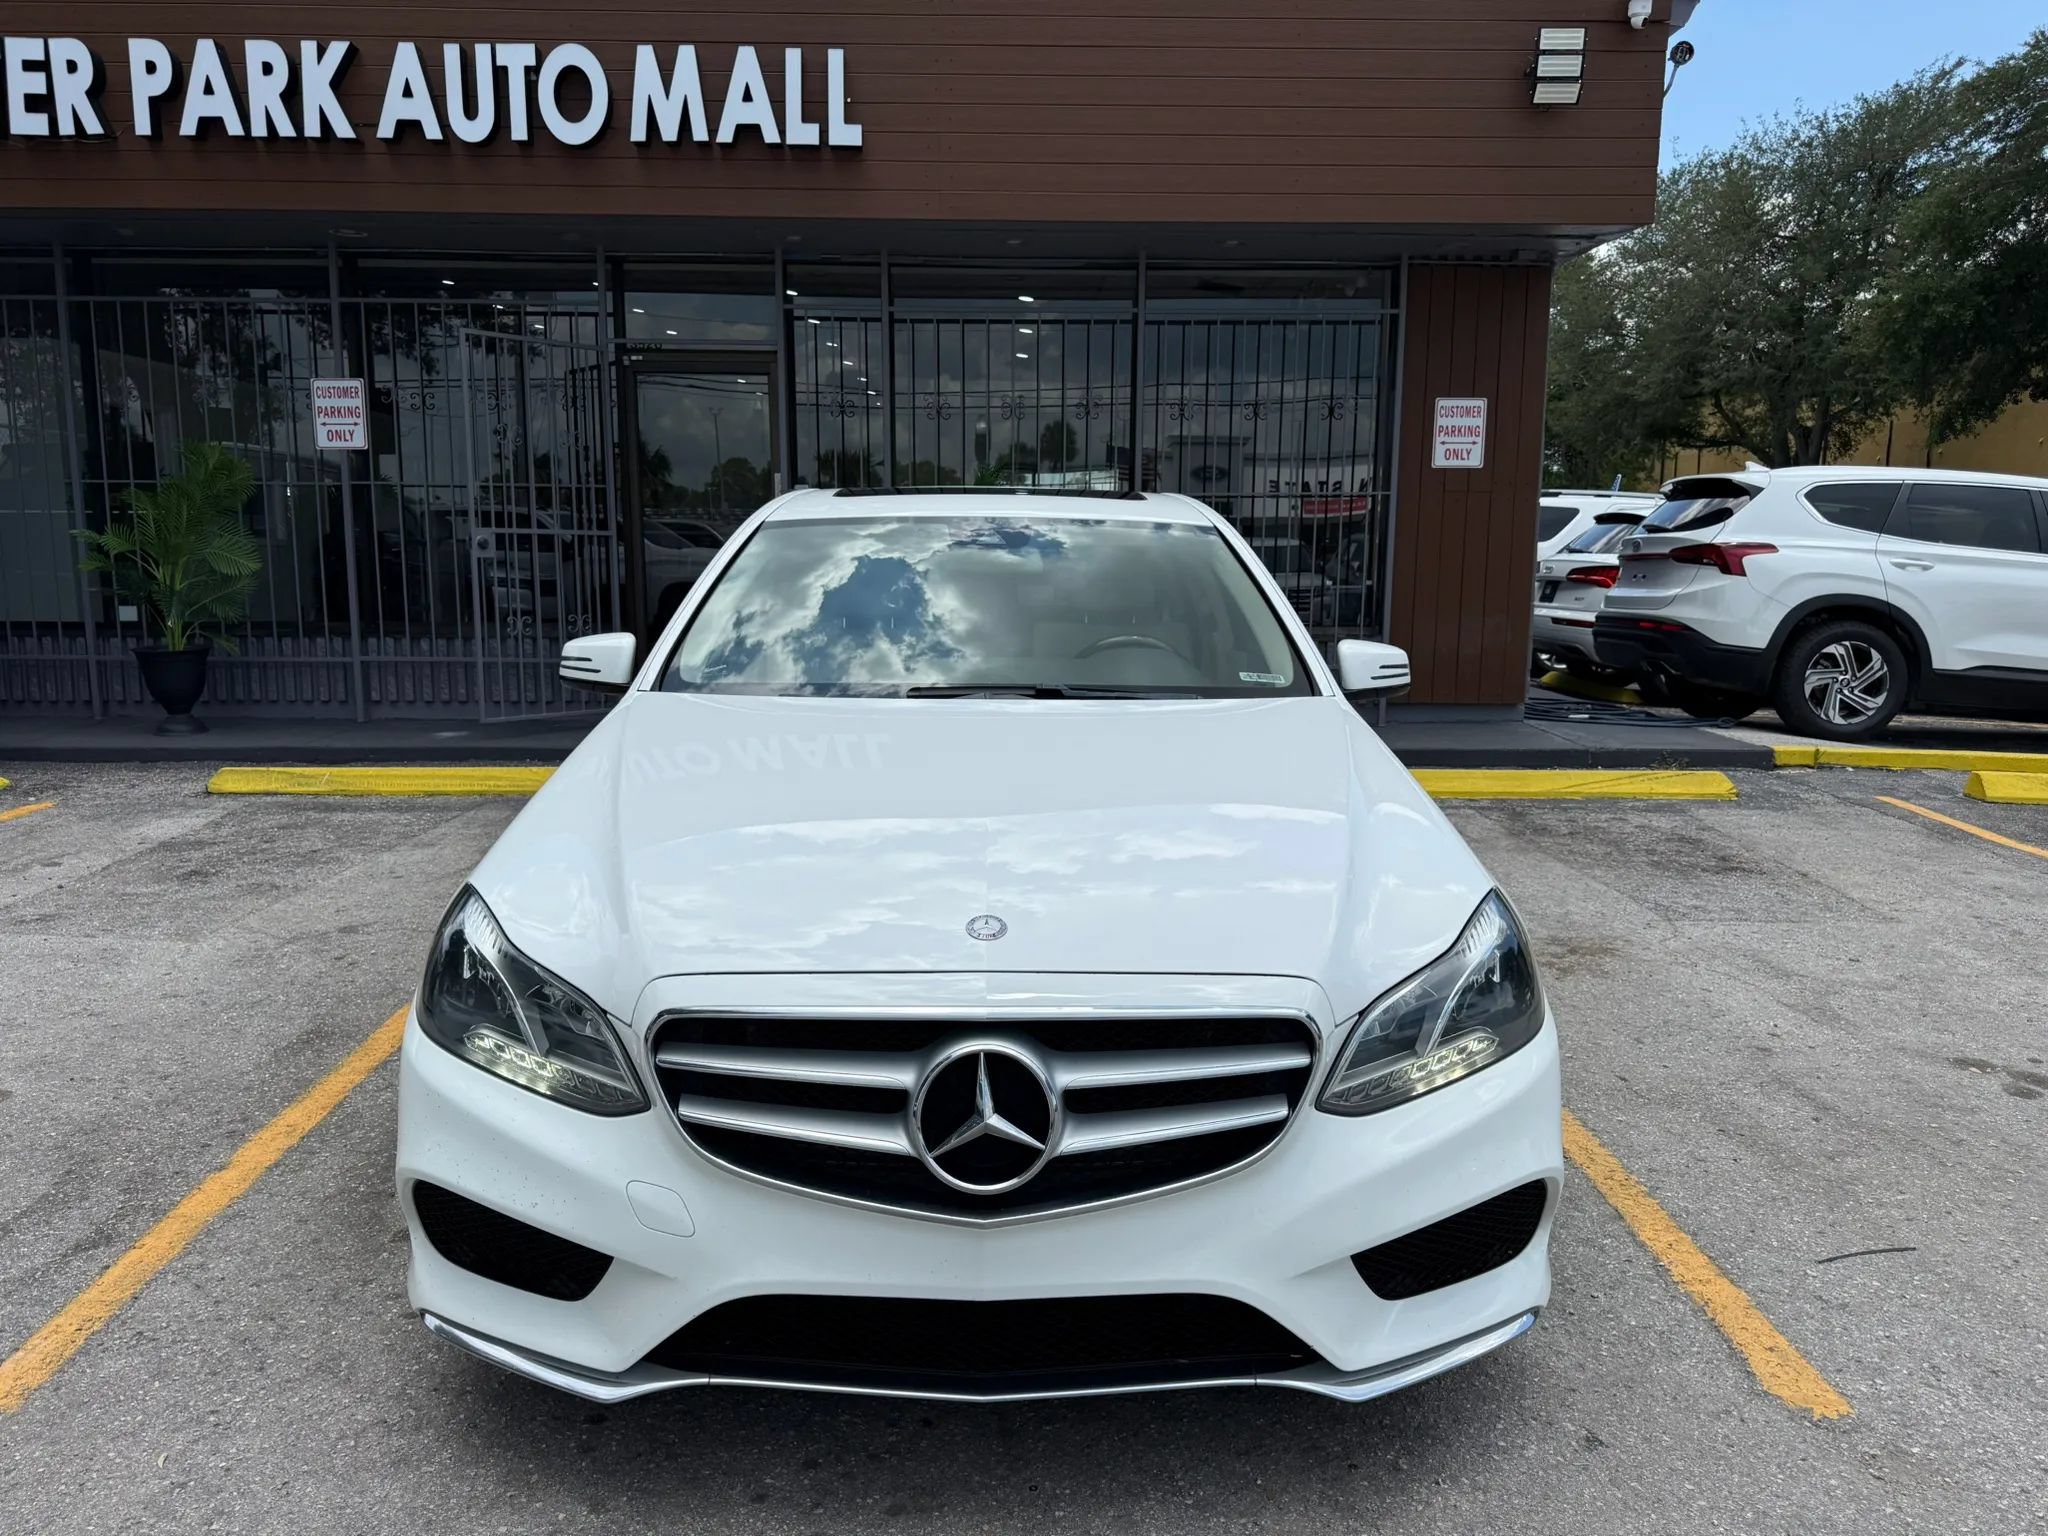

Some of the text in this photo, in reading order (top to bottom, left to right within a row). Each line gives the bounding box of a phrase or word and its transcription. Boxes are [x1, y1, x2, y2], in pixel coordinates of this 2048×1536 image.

[127, 37, 358, 139] PARK
[375, 41, 610, 146] AUTO
[629, 43, 864, 147] MALL
[315, 386, 360, 399] CUSTOMER
[317, 406, 361, 419] PARKING
[1439, 405, 1482, 418] CUSTOMER
[326, 429, 355, 442] ONLY
[1438, 425, 1481, 438] PARKING
[1444, 448, 1472, 461] ONLY
